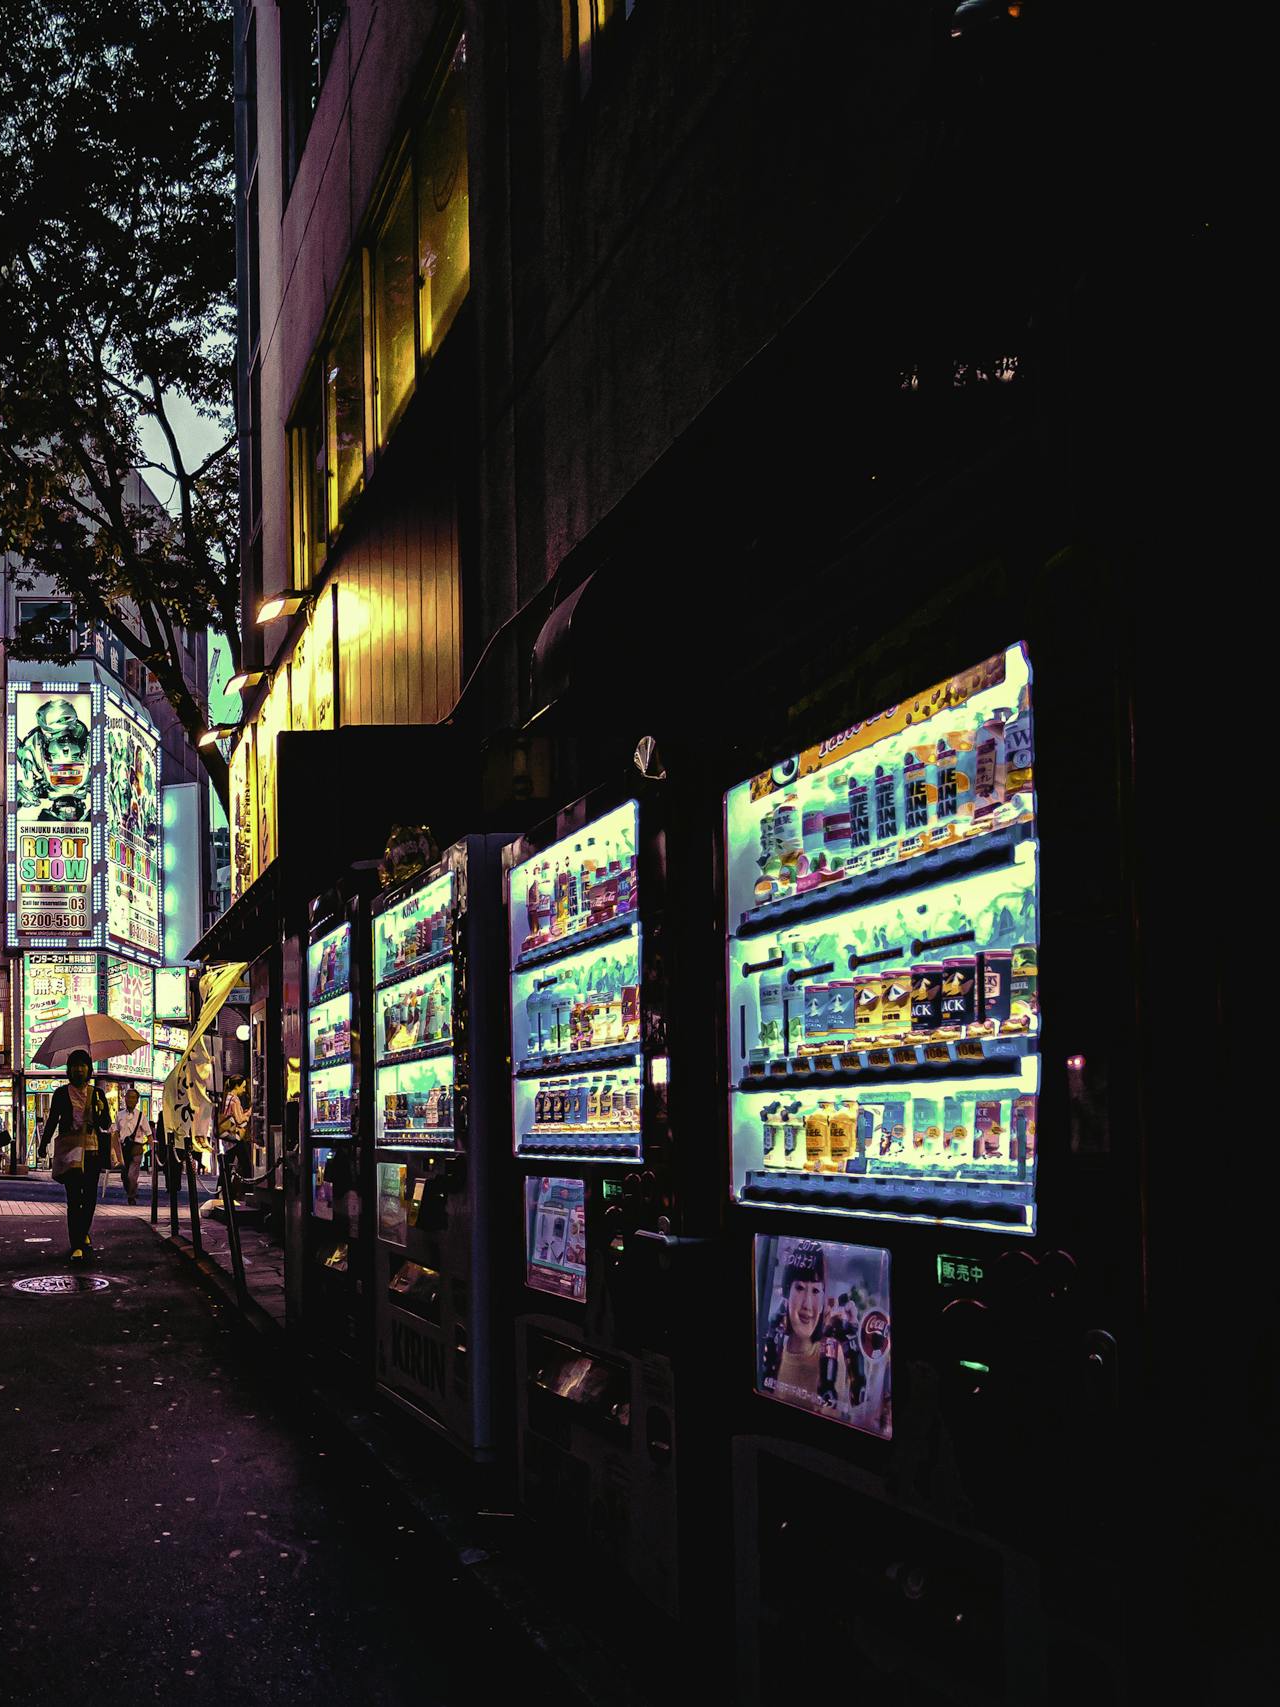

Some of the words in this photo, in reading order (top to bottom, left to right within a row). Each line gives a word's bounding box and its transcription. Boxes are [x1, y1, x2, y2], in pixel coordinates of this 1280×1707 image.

[20, 826, 51, 834] SHINJUKU
[52, 826, 89, 834] KABUKICHO
[22, 837, 87, 859] ROBOT
[22, 859, 87, 880] SHOW
[70, 898, 85, 910] 03
[402, 898, 420, 919] KIRIN
[22, 914, 85, 927] 3200-5500
[120, 1013, 142, 1023] SHIBUYA
[942, 1262, 984, 1284] 販売中
